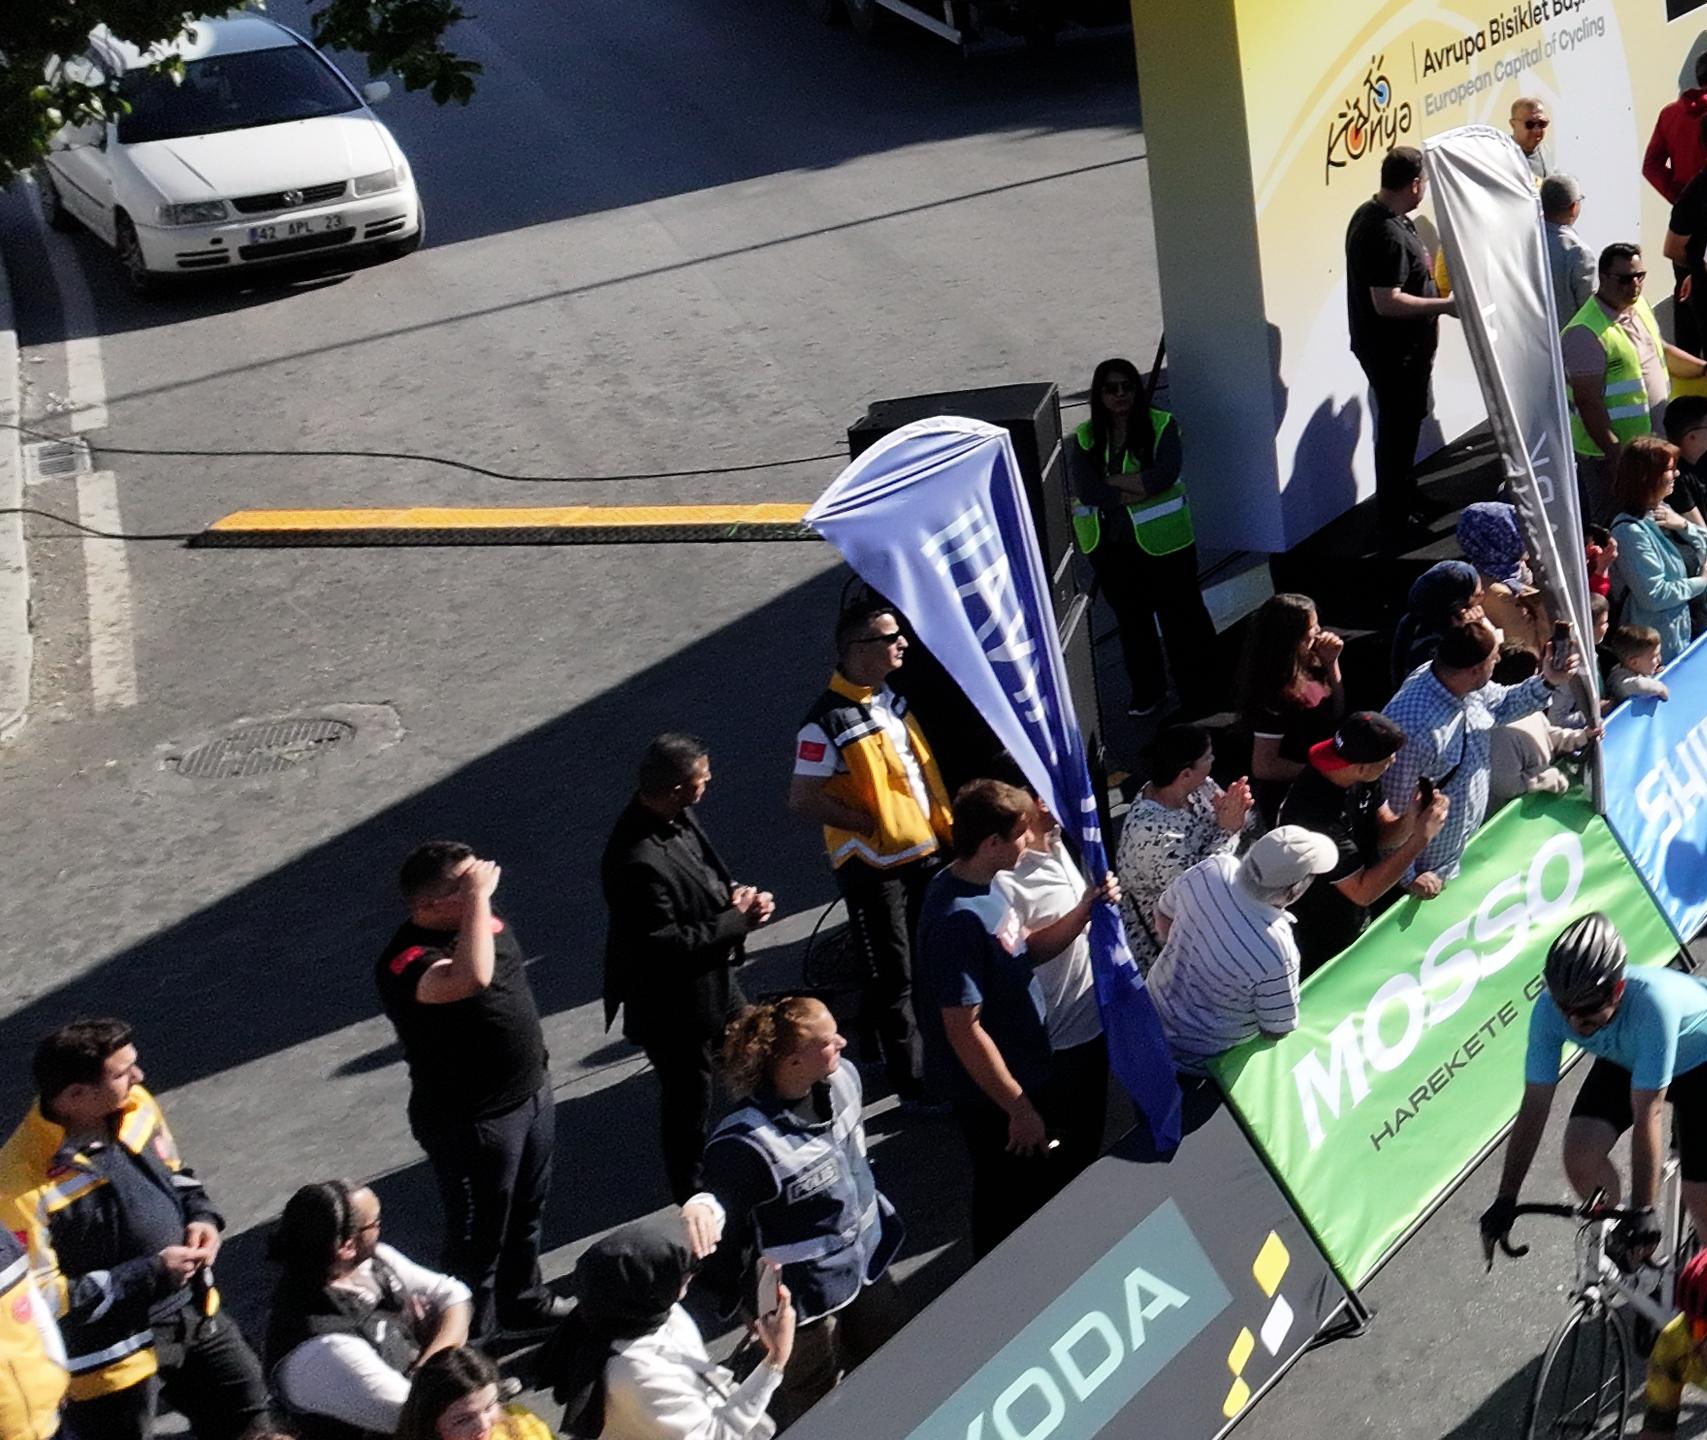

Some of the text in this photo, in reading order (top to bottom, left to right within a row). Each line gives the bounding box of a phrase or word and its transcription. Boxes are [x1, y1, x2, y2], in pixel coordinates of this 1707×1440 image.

[1423, 30, 1486, 78] Avrupa
[1424, 15, 1605, 117] European Capital of Cycling
[260, 226, 277, 240] 42
[326, 215, 342, 229] 23
[1291, 832, 1584, 1150] MOSSO
[1370, 1004, 1521, 1152] HAREKETE
